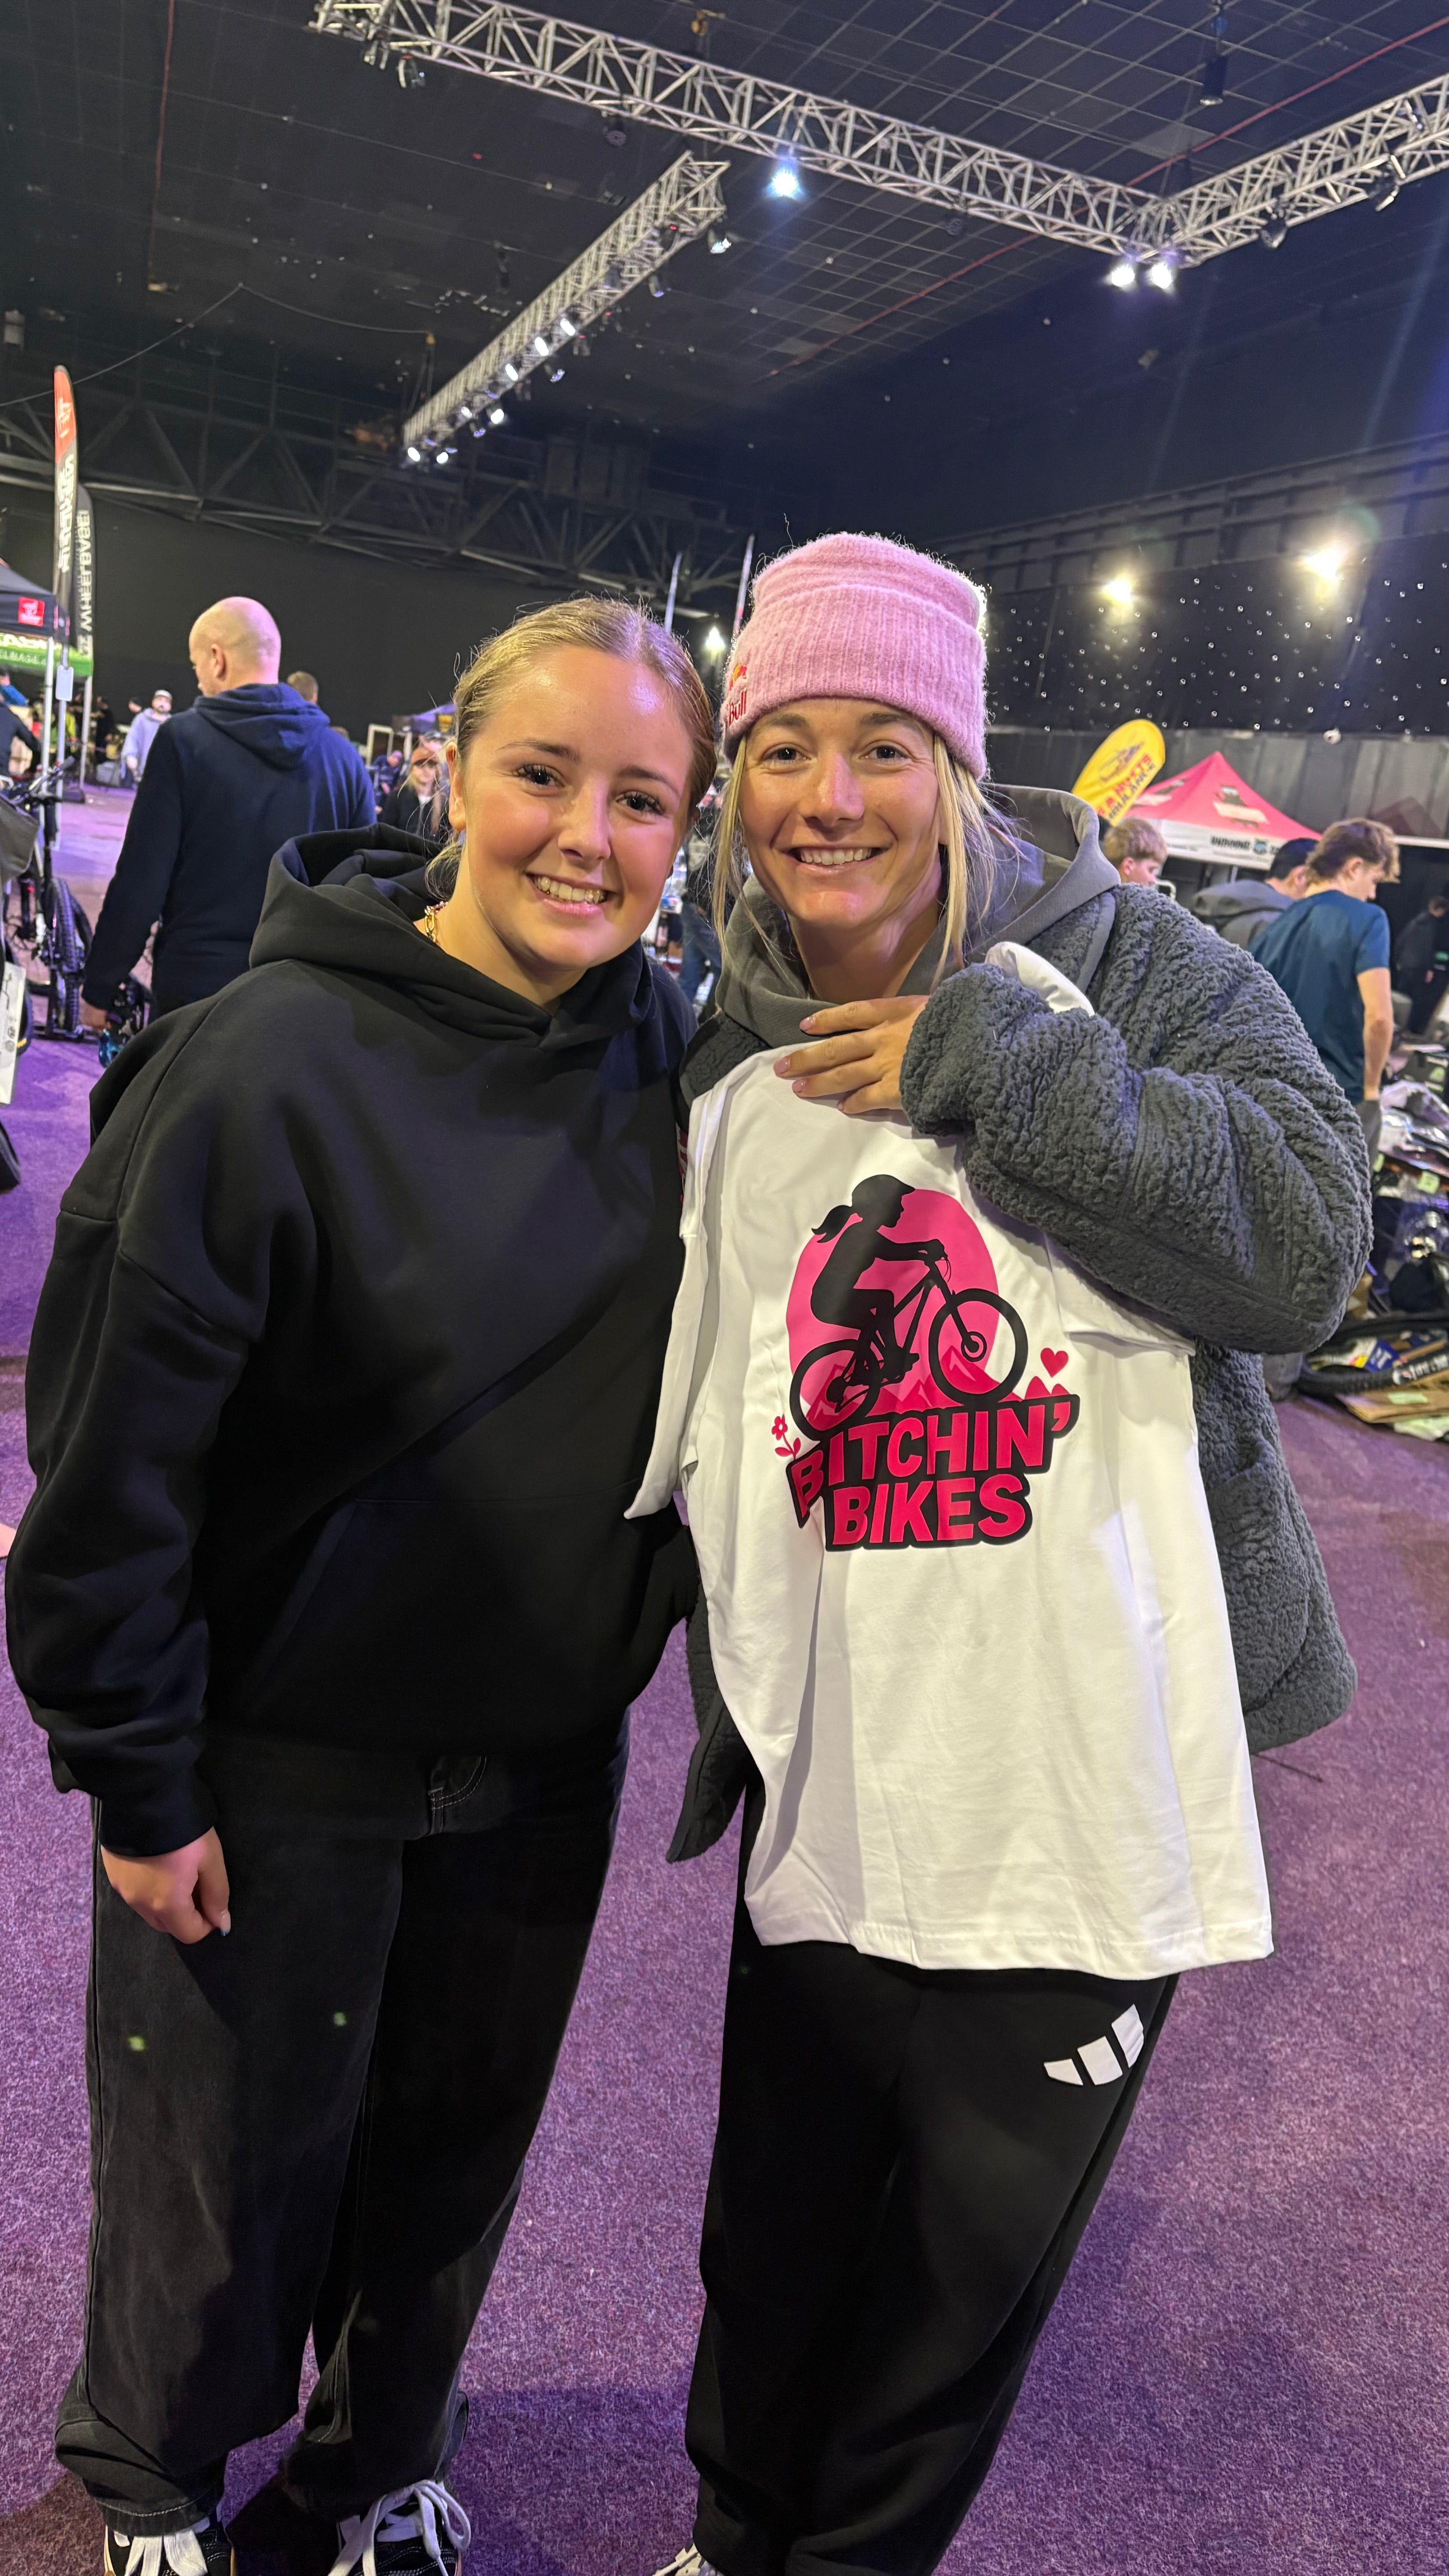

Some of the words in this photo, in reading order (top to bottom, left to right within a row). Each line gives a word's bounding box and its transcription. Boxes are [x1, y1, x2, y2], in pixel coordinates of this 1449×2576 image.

[729, 689, 747, 727] Bull
[791, 1401, 1071, 1519] BITCHIN'
[832, 1473, 1026, 1546] BIKES
